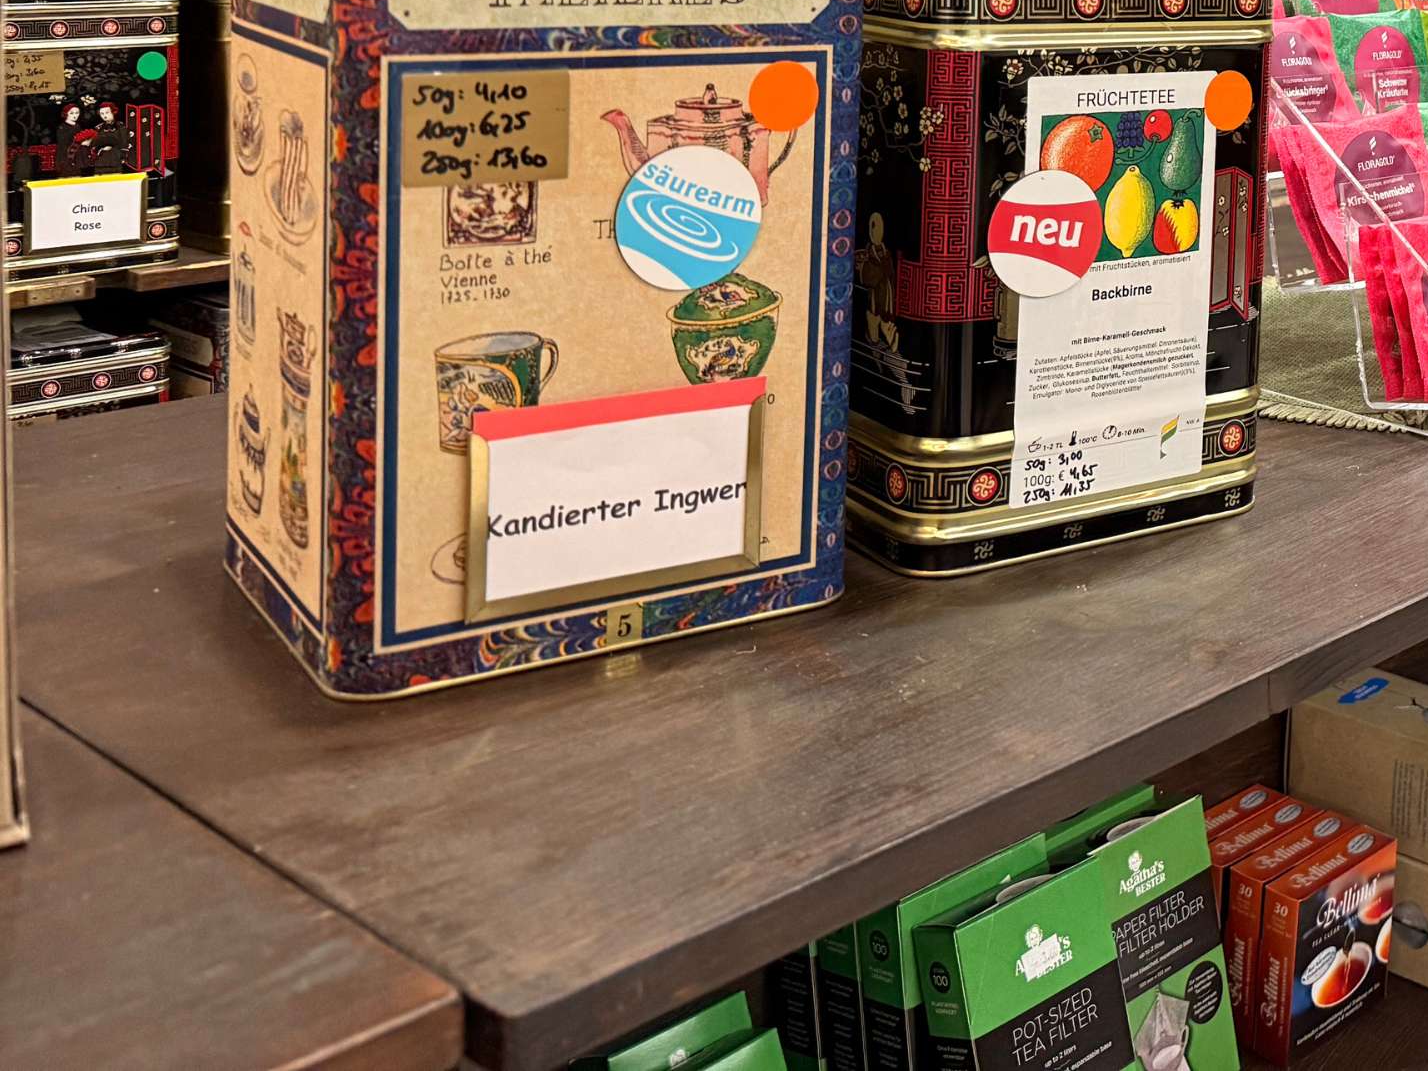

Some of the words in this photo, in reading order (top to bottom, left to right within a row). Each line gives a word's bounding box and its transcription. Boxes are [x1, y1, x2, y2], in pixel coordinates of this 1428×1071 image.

[412, 83, 465, 113] 50g:
[474, 80, 528, 107] 4,10
[1077, 88, 1176, 108] FRÜCHTETEE
[417, 118, 477, 148] 100g:
[478, 111, 532, 140] 6,25
[420, 149, 482, 180] 250g:
[486, 150, 548, 174] 13,60
[1358, 156, 1394, 172] FLORAGOLD
[641, 159, 757, 219] säurearm
[72, 203, 104, 215] China
[74, 220, 101, 232] Rose
[1010, 214, 1084, 248] neu
[504, 249, 516, 267] à
[524, 244, 553, 267] thé
[1102, 259, 1152, 273] Fruchtstücken,
[1152, 254, 1192, 267] aromatisiert
[440, 272, 497, 289] Vienne
[1091, 283, 1153, 302] Backbirne
[1071, 338, 1082, 346] mit
[1024, 456, 1052, 472] 50g:
[1058, 449, 1083, 466] 3,00
[1024, 473, 1055, 488] 100g:
[1058, 470, 1065, 481] €
[1069, 463, 1098, 480] 4,65
[1023, 487, 1055, 505] 250g:
[1060, 478, 1095, 497] 11,35
[487, 499, 641, 539] Kandierter
[653, 481, 747, 512] Ingwer
[617, 614, 632, 638] 5
[1119, 860, 1165, 895] Agatha's
[1135, 872, 1166, 897] BESTER
[1238, 884, 1253, 898] 30
[1316, 873, 1380, 929] Bellima
[1112, 913, 1148, 942] PAPER
[1149, 890, 1186, 926] FILTER
[1273, 903, 1288, 917] 30
[1119, 925, 1157, 958] FILTER
[1158, 896, 1205, 936] HOLDER
[1012, 987, 1093, 1048] POT-SIZED
[1012, 1037, 1046, 1067] TEA
[1049, 1004, 1099, 1051] FILTER
